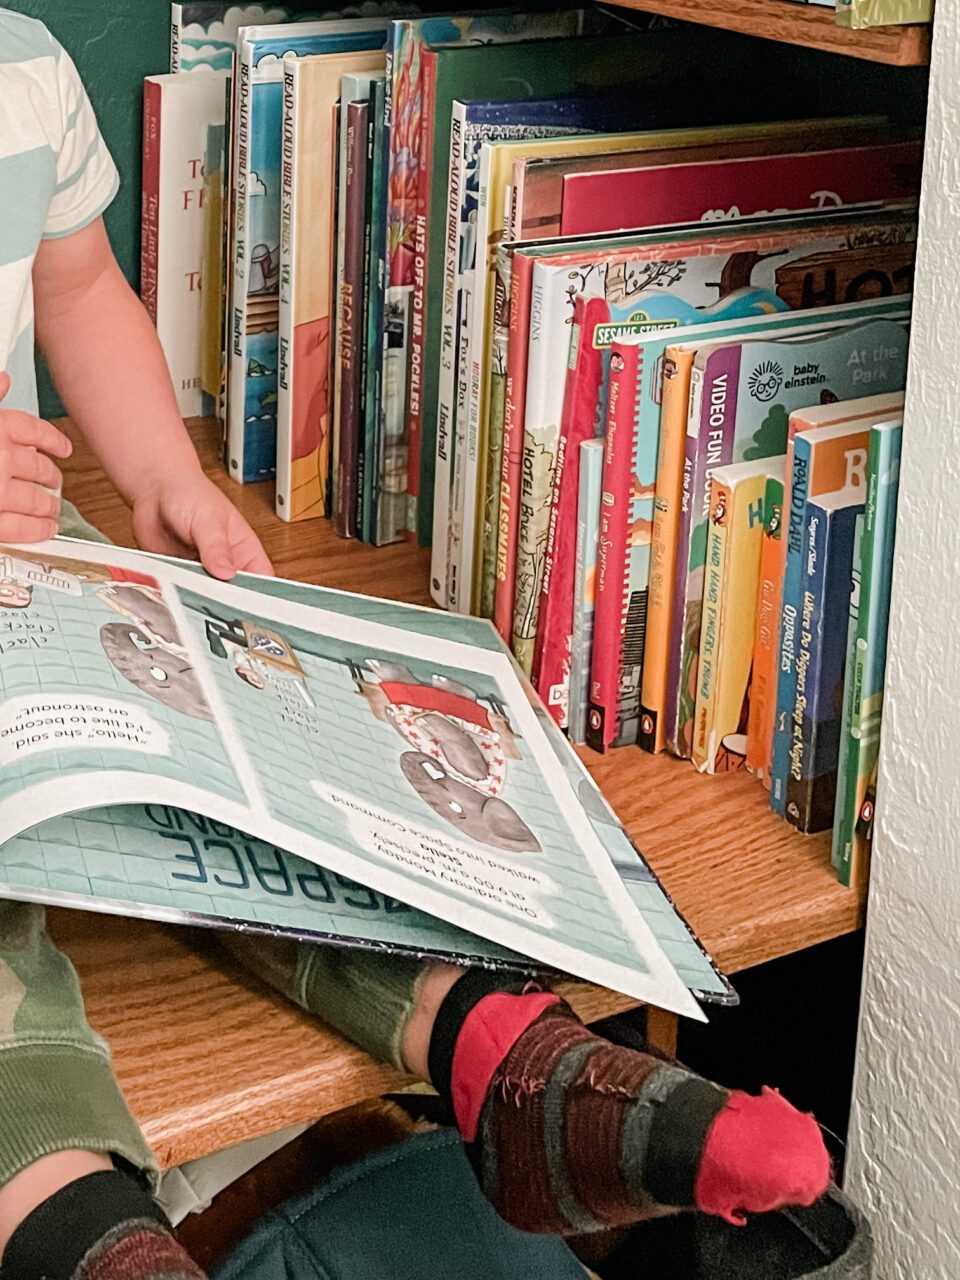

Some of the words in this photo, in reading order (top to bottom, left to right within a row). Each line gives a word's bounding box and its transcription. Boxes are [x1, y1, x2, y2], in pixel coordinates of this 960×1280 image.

[238, 62, 249, 142] READ-ALOUD
[283, 72, 295, 161] READ-ALOUD
[238, 144, 248, 181] BIBLE
[282, 162, 294, 199] BIBLE
[448, 118, 461, 212] READ-ALOUD
[148, 193, 158, 221] Ten
[236, 181, 247, 233] STORIES
[480, 186, 488, 207] WON
[147, 224, 157, 261] Little
[281, 202, 293, 256] STORIES
[414, 215, 426, 253] HATS
[446, 213, 458, 255] BIBLE
[414, 256, 425, 286] OFF
[443, 259, 455, 316] STORIES
[413, 290, 423, 310] TO
[510, 274, 520, 332] HIGGINS
[532, 284, 543, 342] HIGGINS
[233, 307, 245, 358] Lindvall
[412, 312, 422, 338] MR.
[279, 336, 291, 390] Lindvall
[441, 362, 452, 370] 3
[459, 335, 469, 379] Fox's
[793, 362, 820, 376] baby
[847, 349, 867, 366] At
[872, 345, 898, 362] the
[409, 343, 421, 416] POCKLES!
[457, 380, 467, 409] Box
[469, 361, 480, 401] HOORAY
[505, 377, 514, 396] we
[784, 373, 826, 389] einstein
[852, 369, 887, 386] Park
[468, 402, 478, 421] FOR
[504, 398, 515, 430] don't
[436, 403, 450, 461] Lindvall
[467, 423, 478, 462] BOOKS!
[502, 435, 511, 454] eat
[501, 455, 510, 479] our
[522, 447, 535, 497] HOTEL
[554, 435, 567, 485] Bedtime
[683, 457, 693, 471] At
[552, 488, 560, 504] on
[682, 472, 691, 489] the
[791, 454, 807, 510] ROALD
[681, 490, 691, 512] Park
[495, 481, 511, 582] CLASSMATES
[519, 502, 534, 543] Bruce
[546, 507, 559, 553] Sesame
[788, 512, 804, 554] DAHL
[542, 556, 553, 594] Street
[801, 591, 815, 629] Where
[781, 604, 797, 673] Opposites
[800, 632, 811, 647] Do
[794, 649, 811, 693] Diggers
[0, 717, 65, 737] become
[69, 716, 86, 724] to
[92, 717, 120, 728] like
[792, 695, 806, 723] Sleep
[793, 725, 803, 738] at
[789, 739, 803, 780] Night?
[373, 843, 437, 878] Monday,
[420, 843, 462, 866] Stella
[440, 872, 501, 903] ordinary
[506, 900, 537, 918] One
